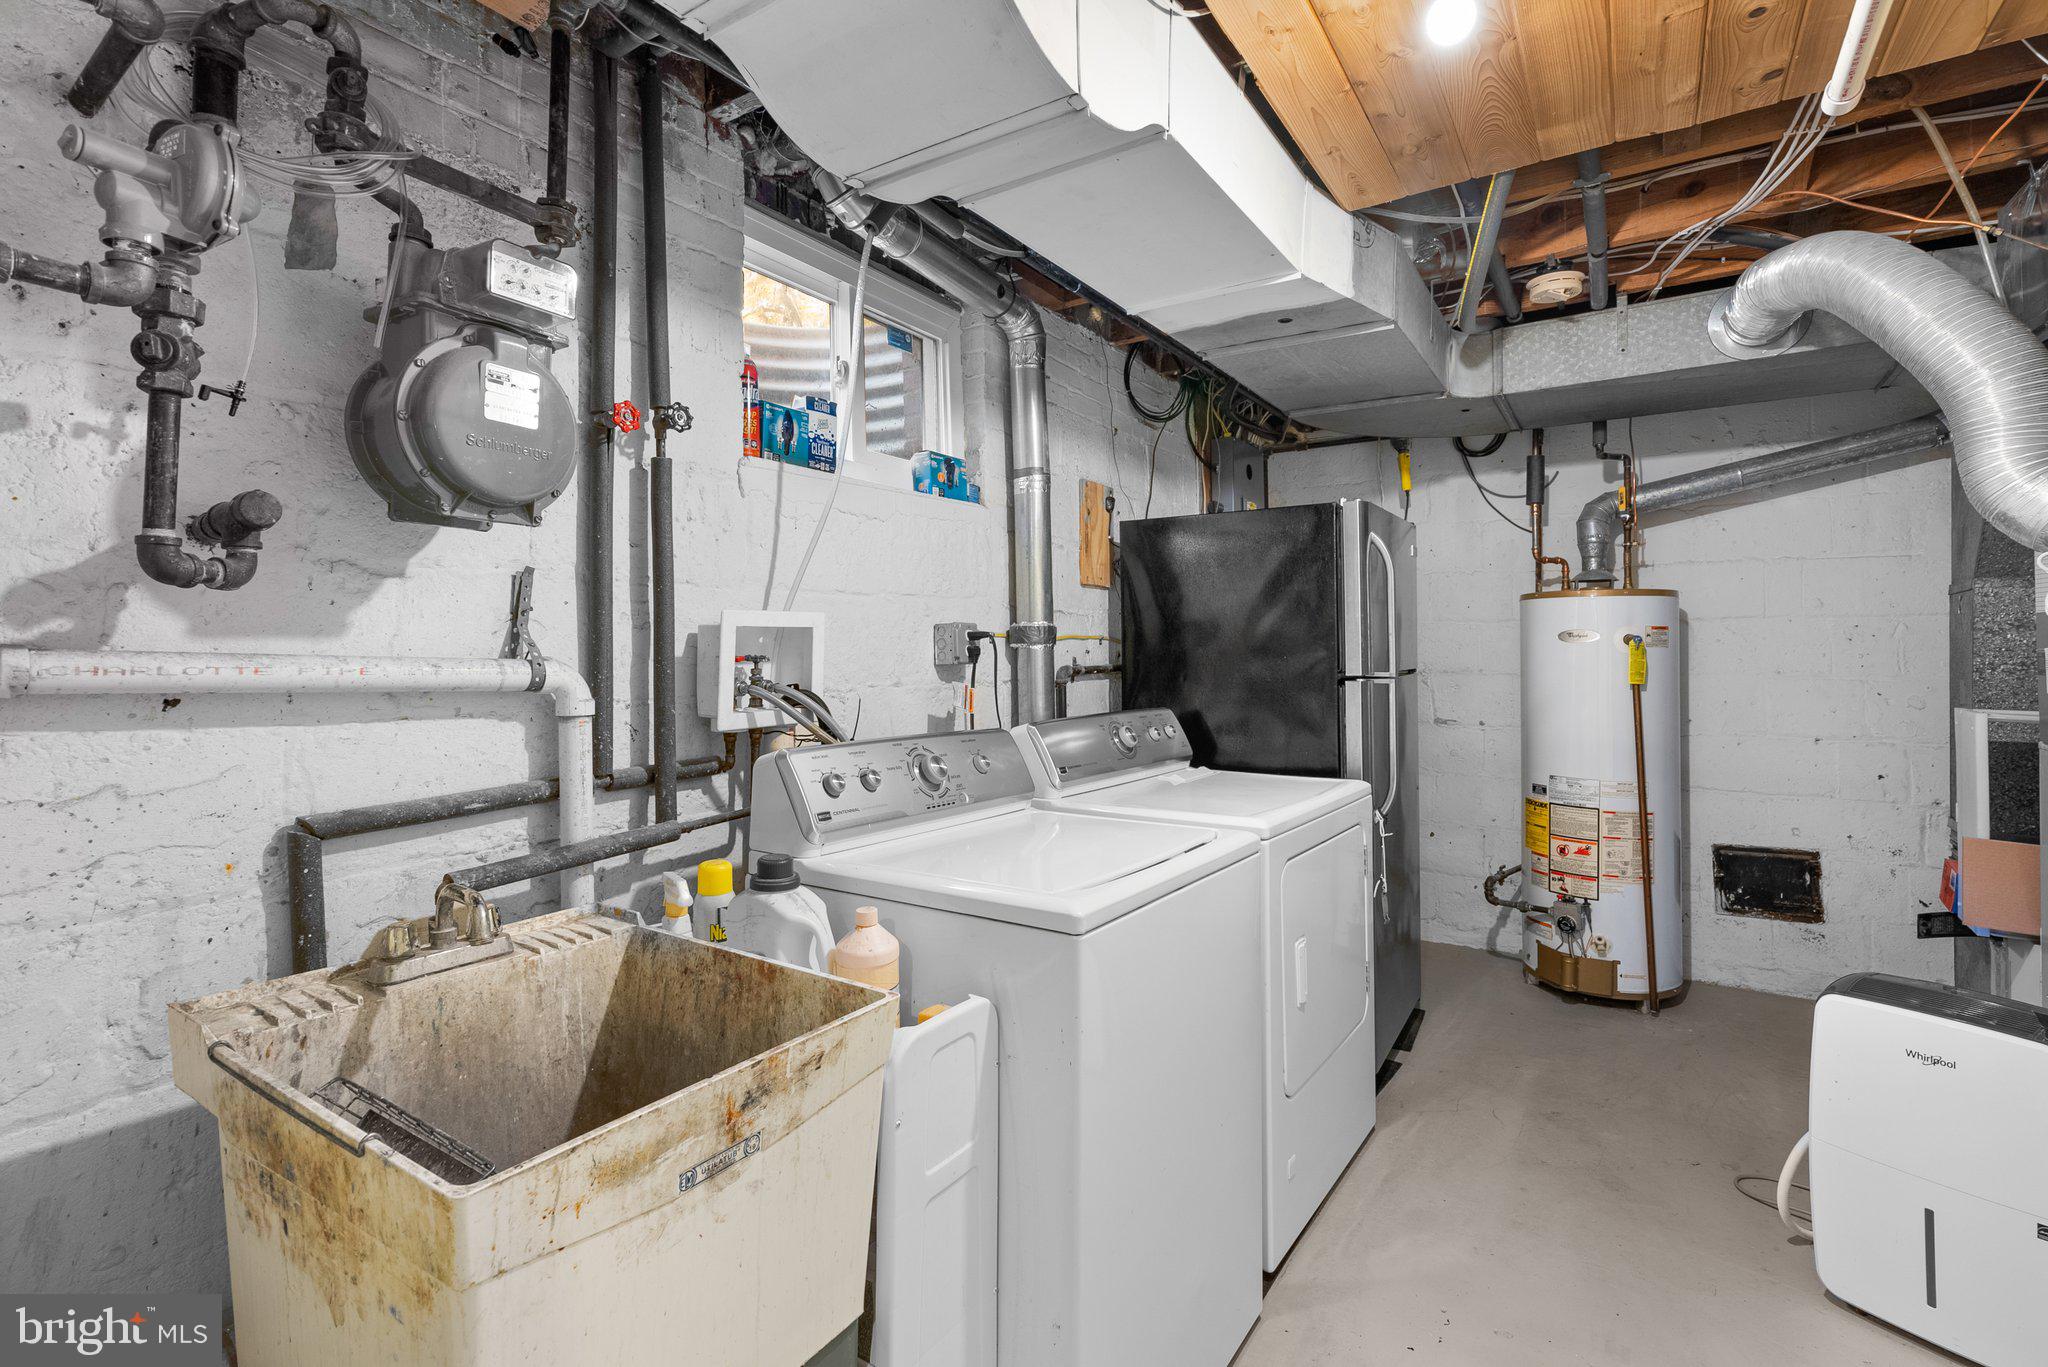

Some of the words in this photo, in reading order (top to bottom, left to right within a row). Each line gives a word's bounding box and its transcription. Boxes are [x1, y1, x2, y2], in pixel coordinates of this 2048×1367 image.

[465, 433, 553, 461] Schlumberger
[811, 442, 834, 459] CLEANER
[47, 665, 273, 677] CHARLOTTE
[832, 807, 861, 816] CENTENNIAL
[1904, 1048, 1957, 1070] Whirlpool
